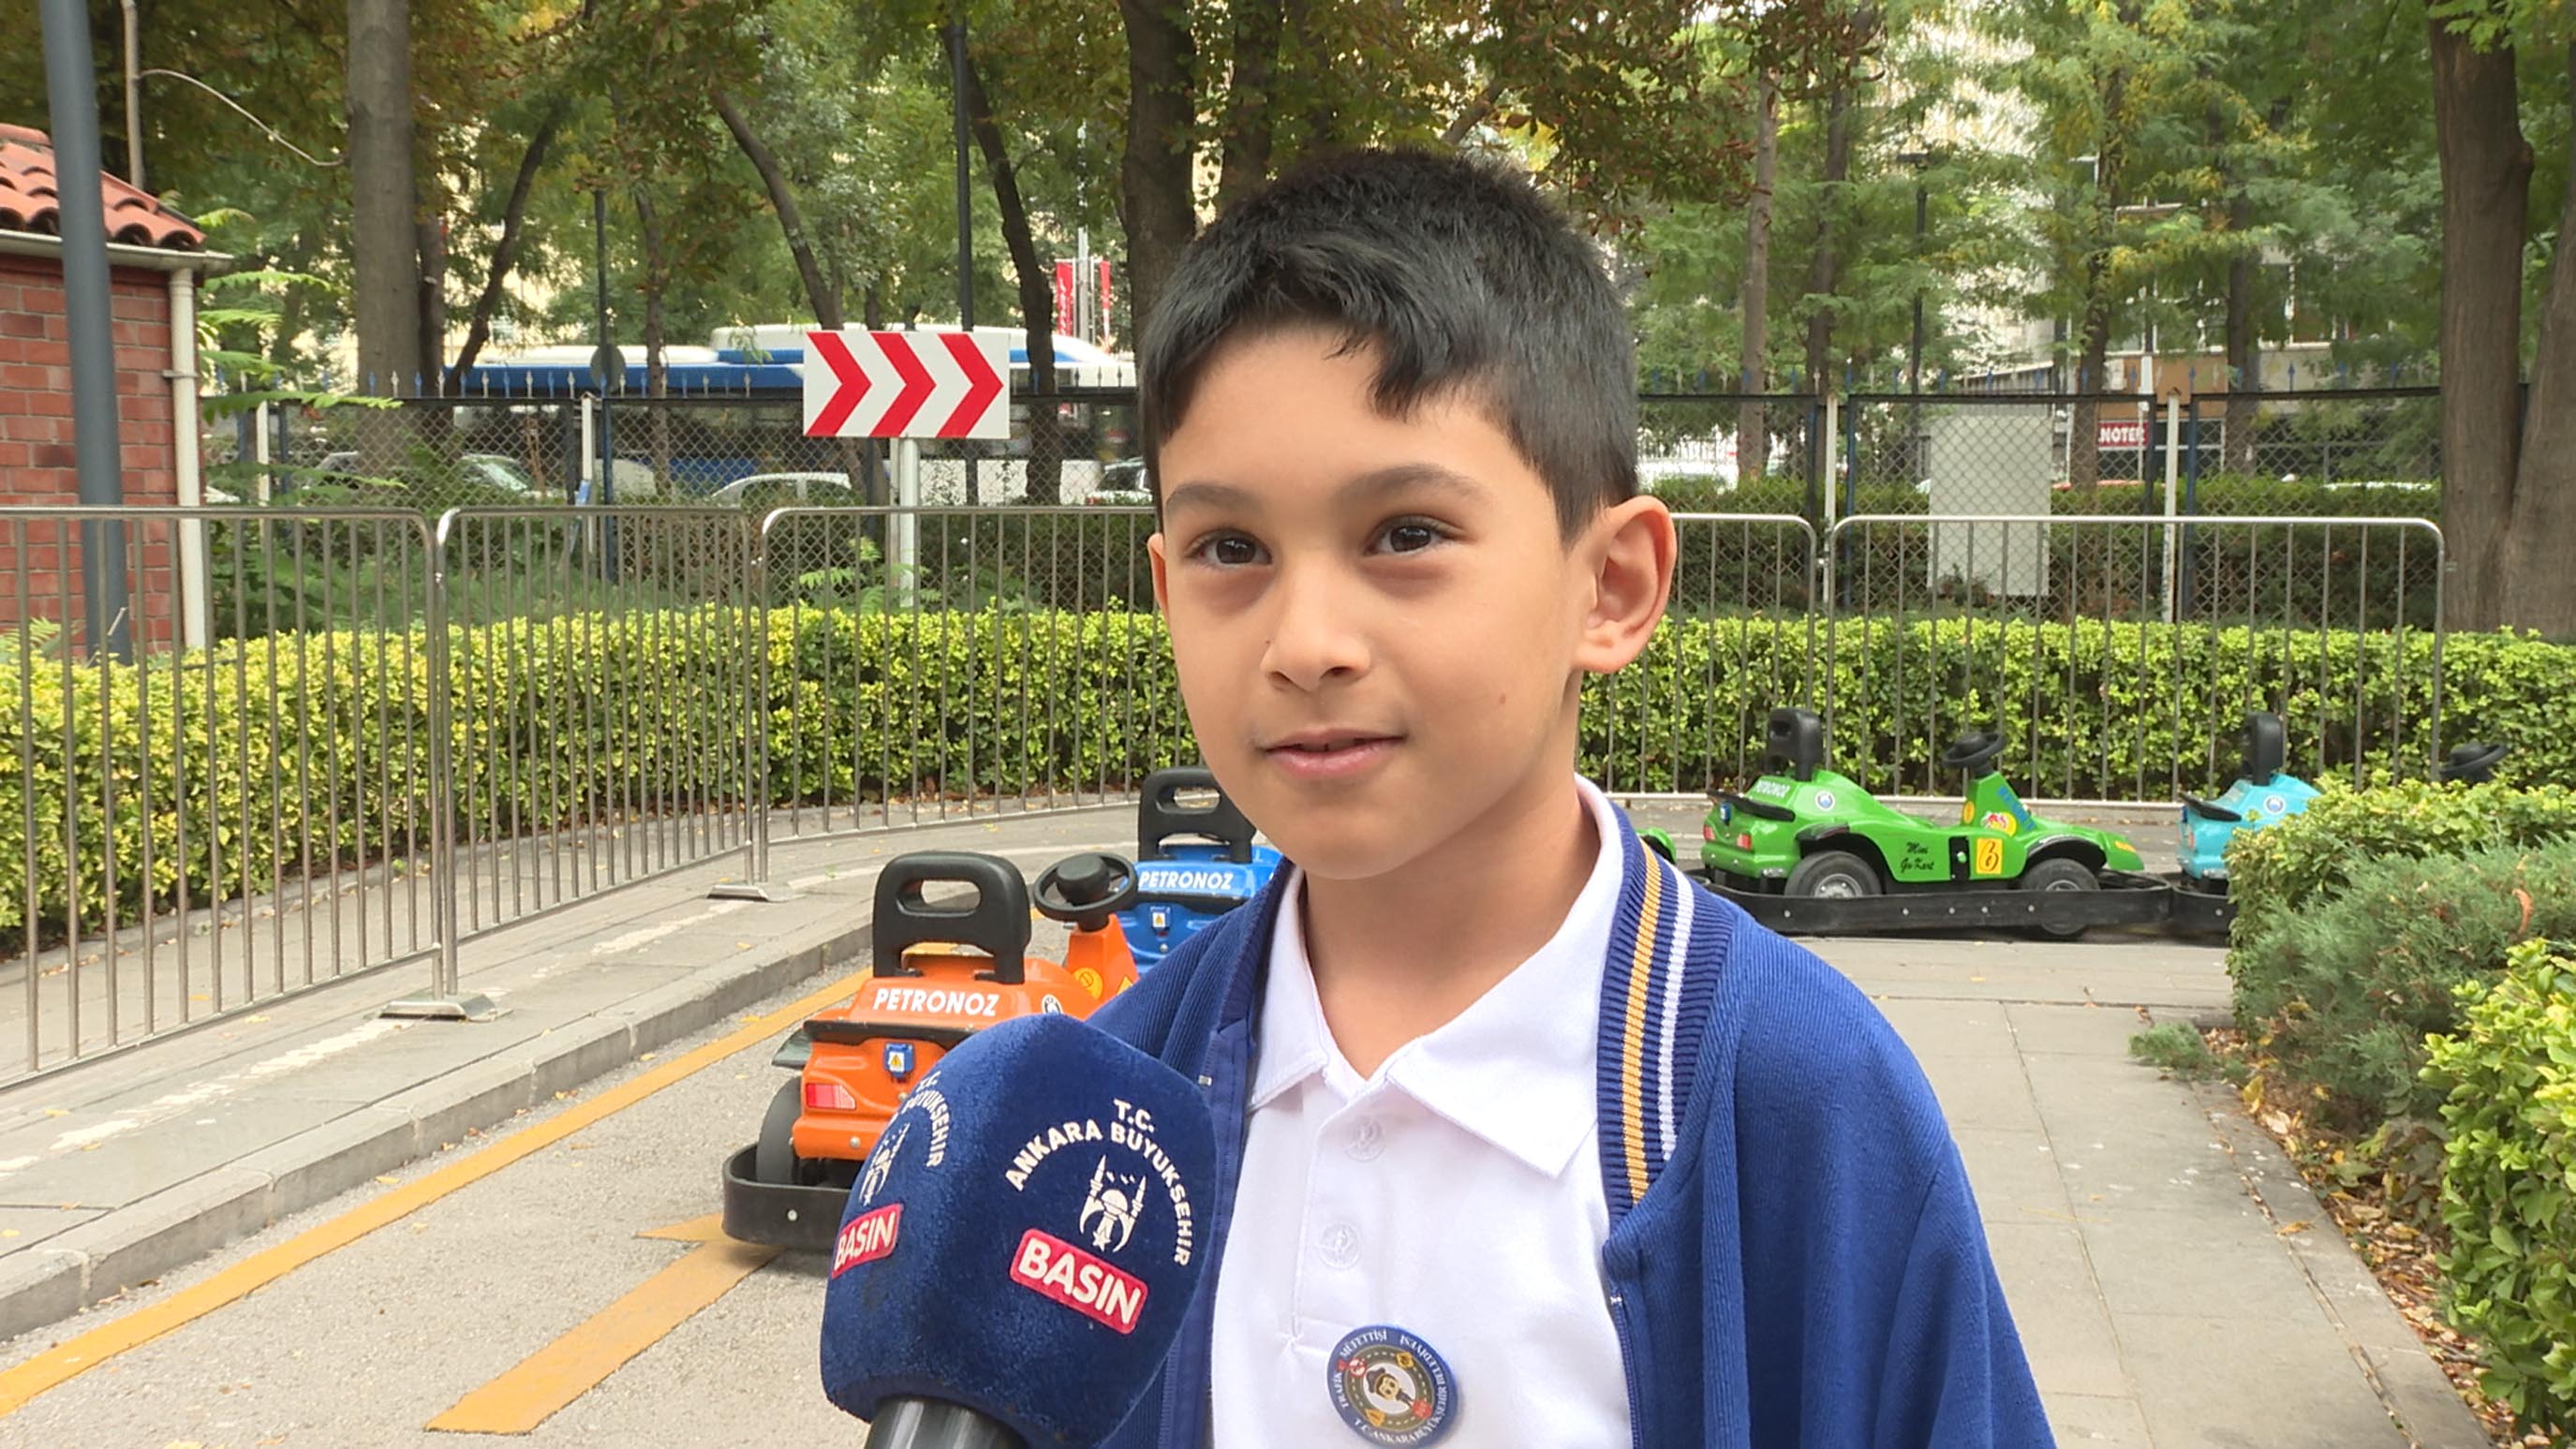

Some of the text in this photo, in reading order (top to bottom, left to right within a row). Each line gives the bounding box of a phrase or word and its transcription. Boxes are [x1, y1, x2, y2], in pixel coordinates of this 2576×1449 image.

[1978, 841, 2000, 872] 6
[1138, 870, 1234, 890] PETRONOZ
[872, 987, 999, 1016] PETRONOZ
[1113, 1098, 1155, 1133] T.C.
[1005, 1118, 1103, 1191] ANKARA
[834, 1211, 896, 1271] BASIN
[1018, 1237, 1141, 1324] BASIN
